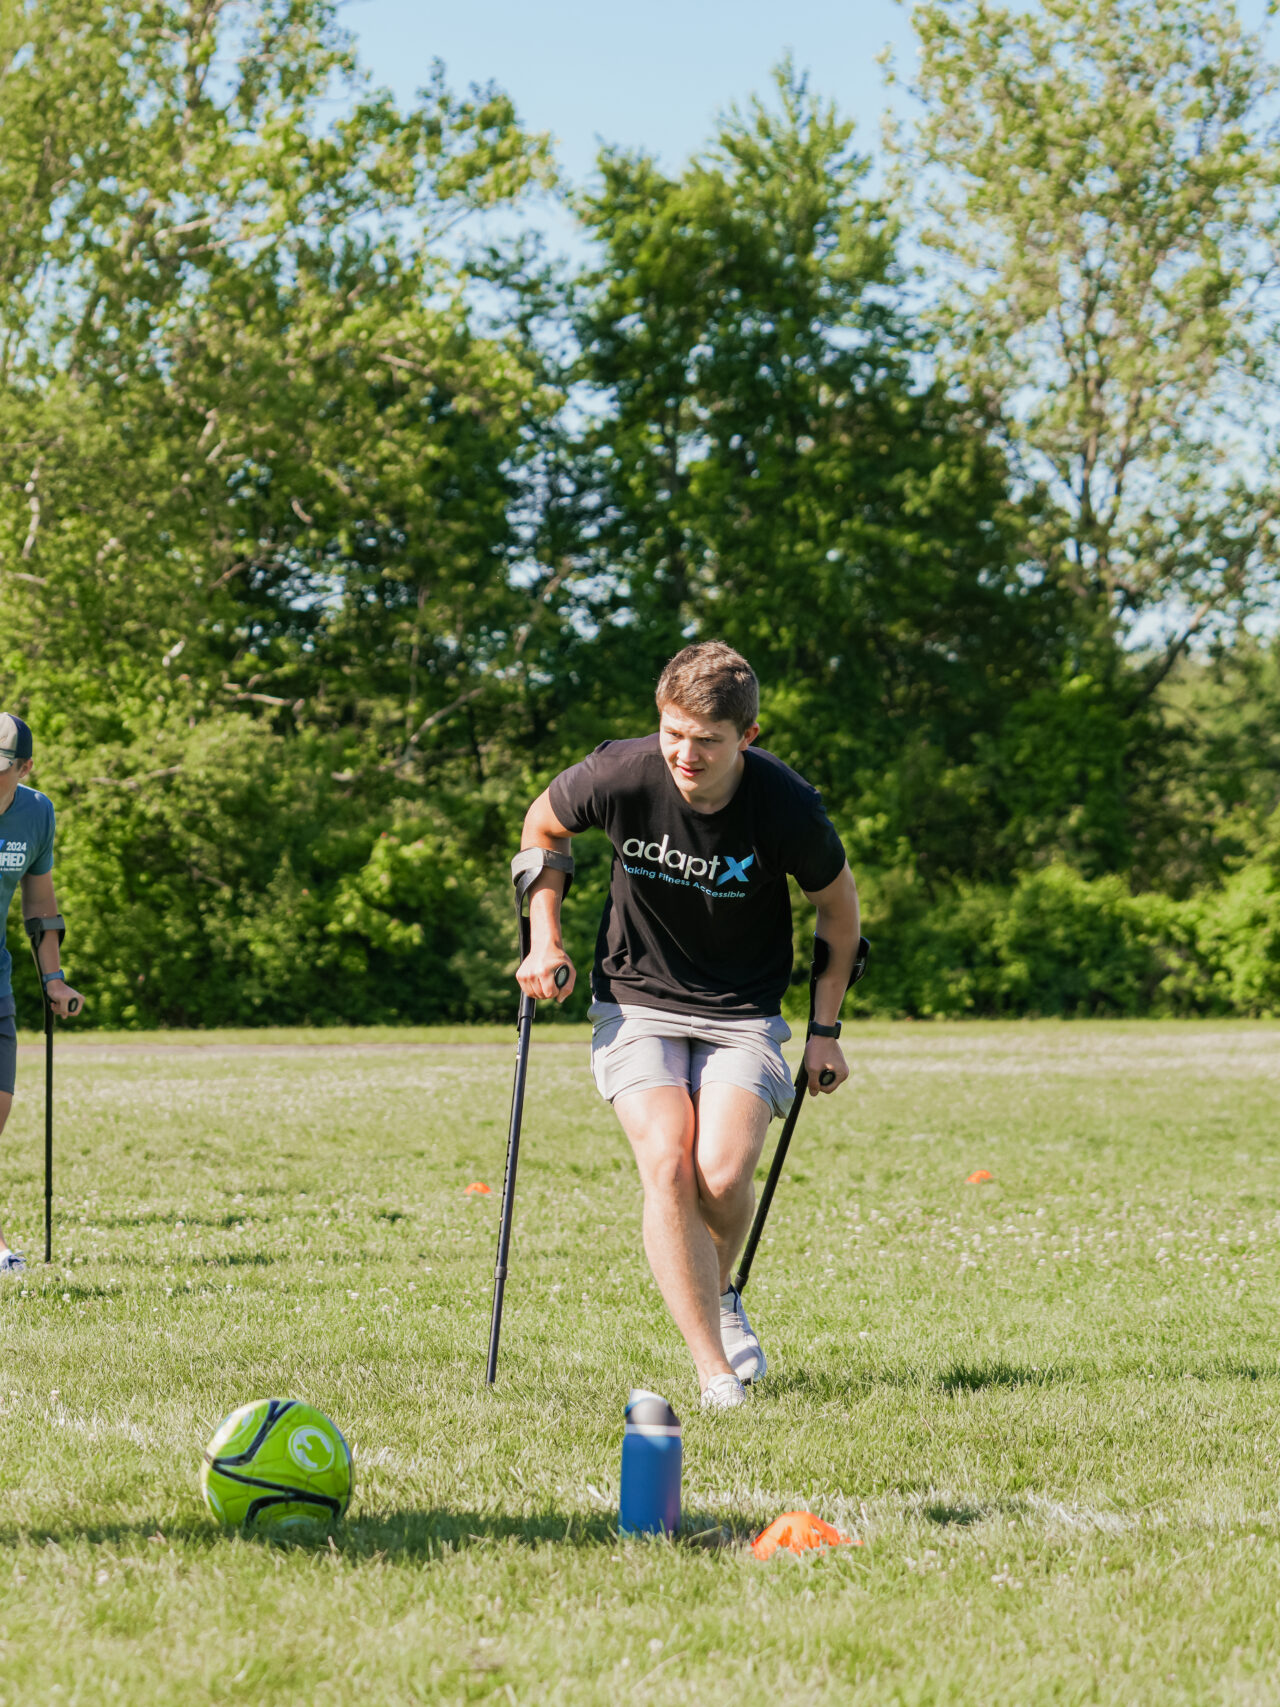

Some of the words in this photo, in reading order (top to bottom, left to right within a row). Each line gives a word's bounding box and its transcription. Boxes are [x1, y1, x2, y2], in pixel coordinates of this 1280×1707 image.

[6, 842, 27, 852] 2024
[658, 872, 690, 887] Fitness
[693, 881, 746, 898] Accessible
